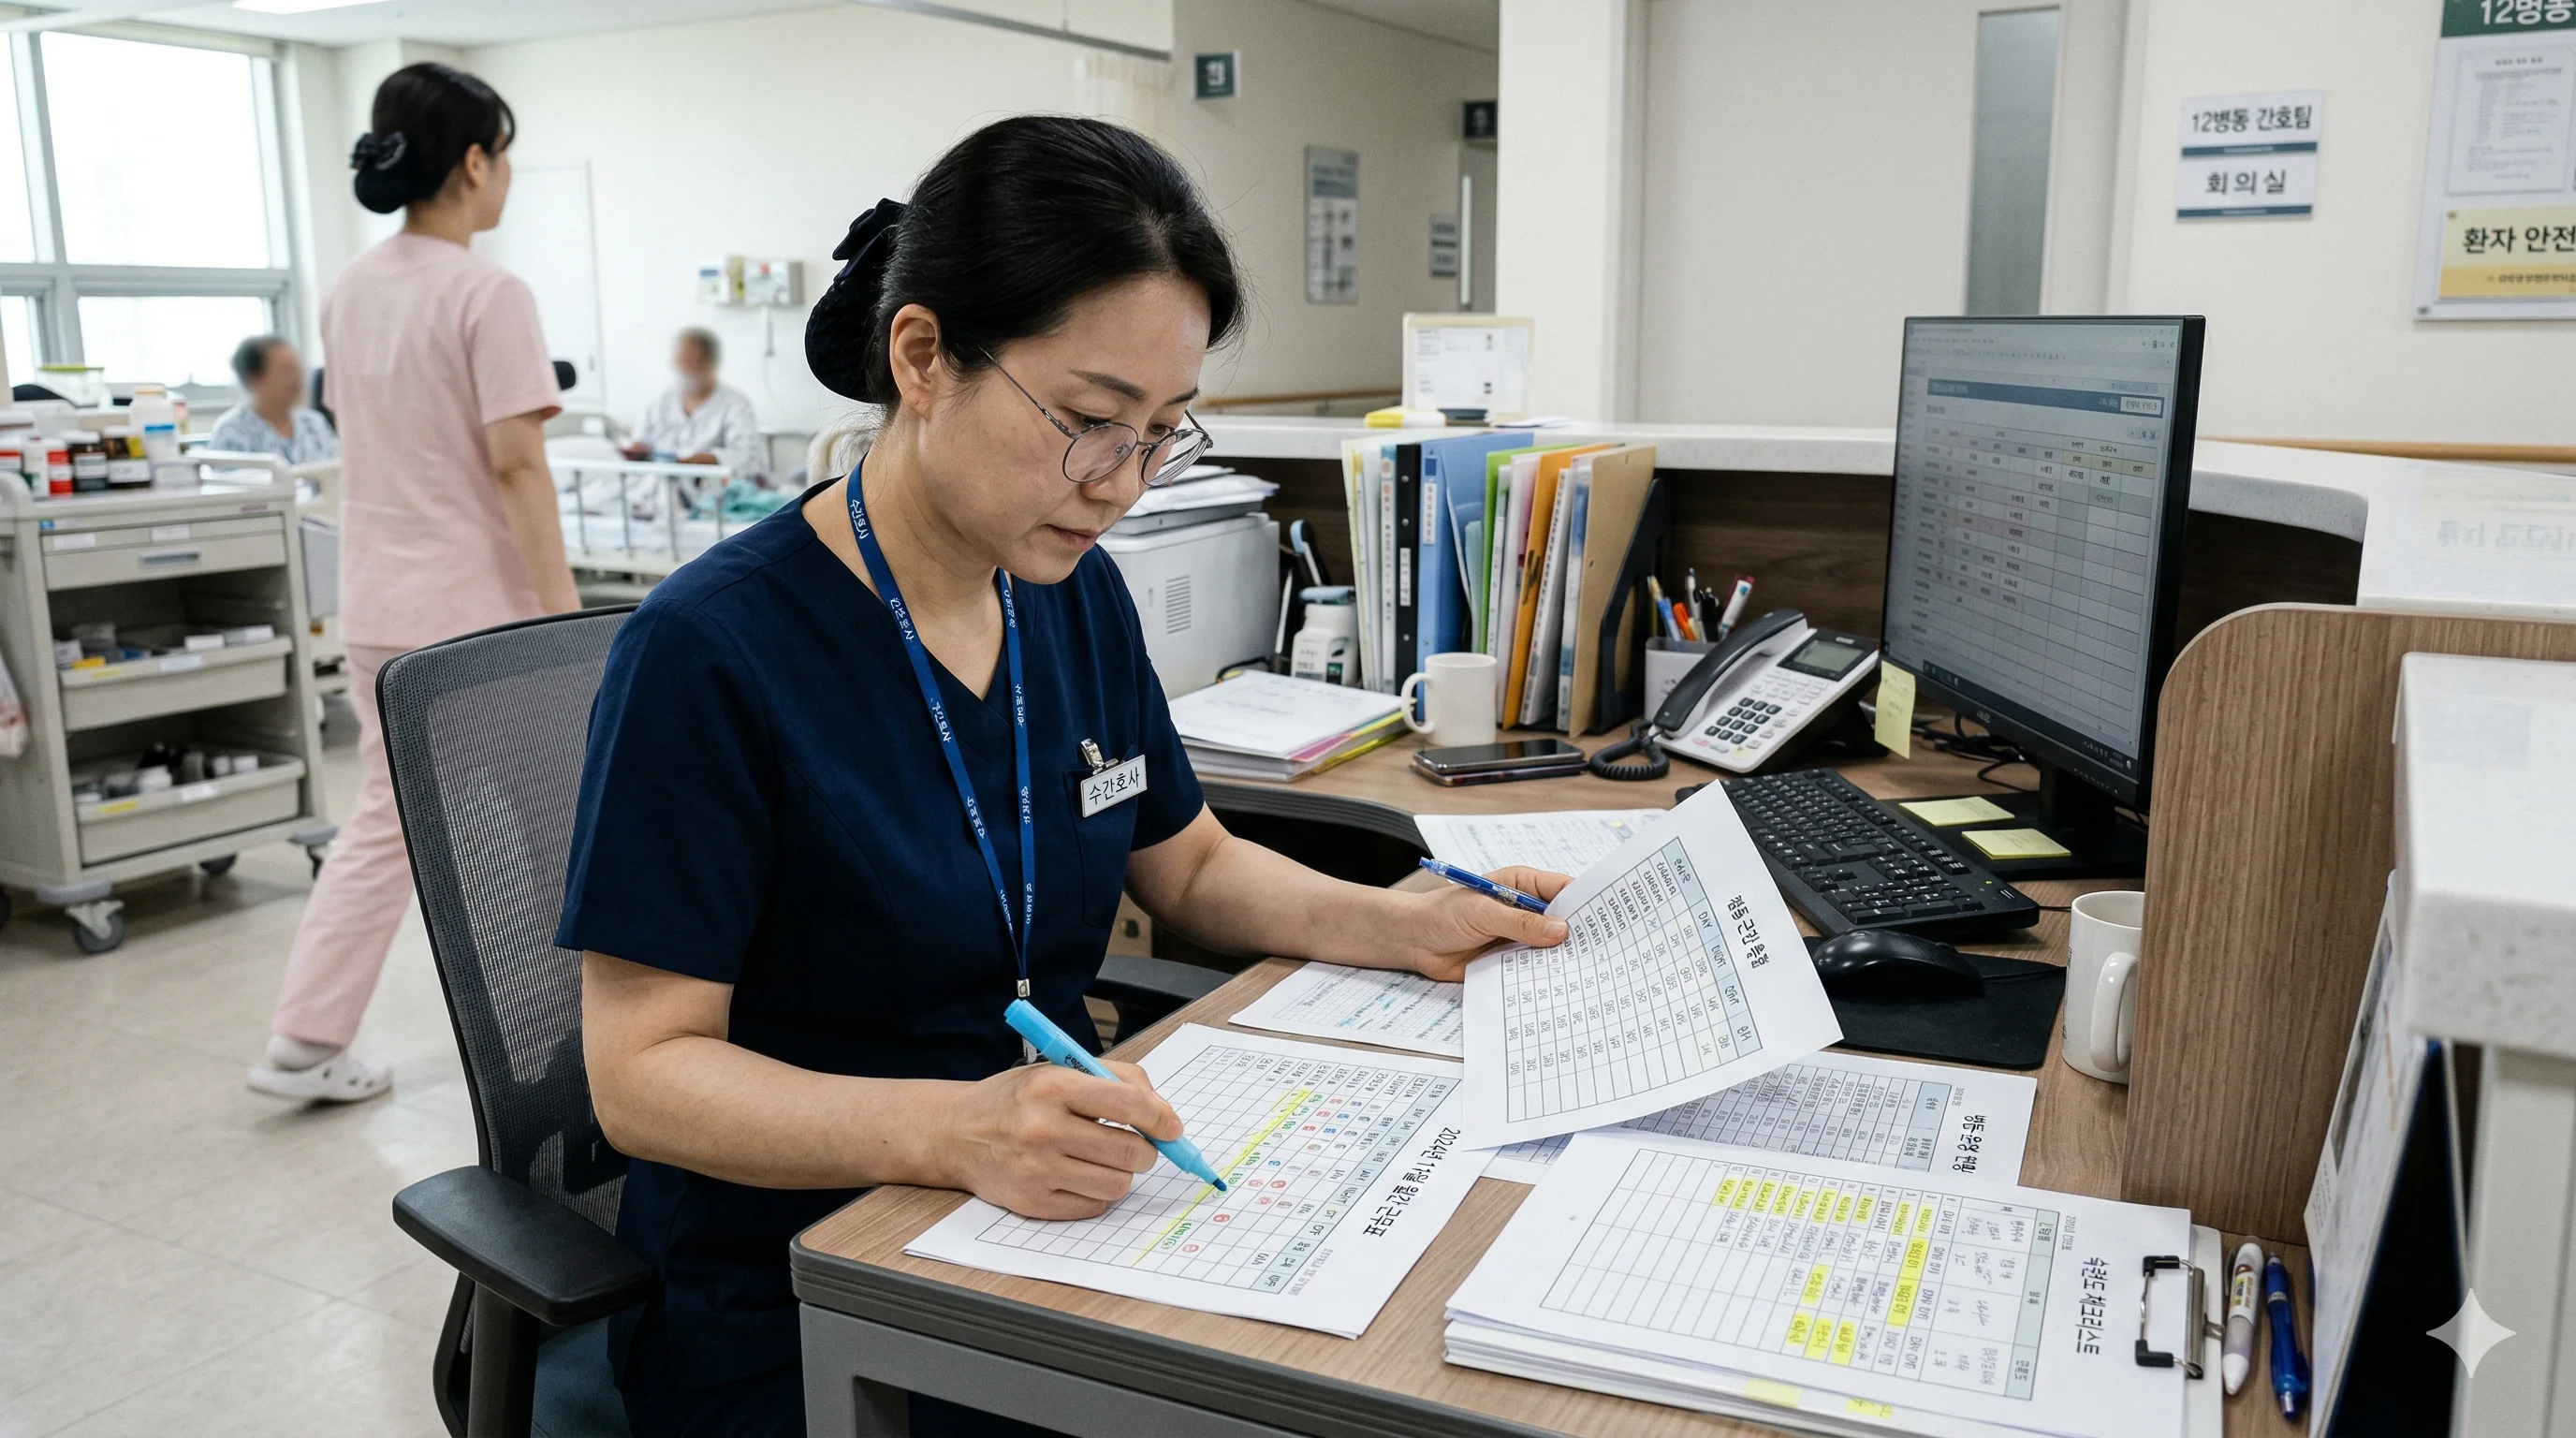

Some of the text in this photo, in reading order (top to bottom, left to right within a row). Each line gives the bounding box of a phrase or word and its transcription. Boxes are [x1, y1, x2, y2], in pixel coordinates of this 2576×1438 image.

[2192, 105, 2312, 134] 12병동 간호팀
[2463, 225, 2576, 254] 환자 안전
[1089, 766, 1140, 805] 수간호사
[1420, 1127, 1461, 1160] 2024년
[1385, 1184, 1419, 1206] 월간
[1362, 1206, 1402, 1237] 근무표
[2075, 1292, 2107, 1355] 체크리스트
